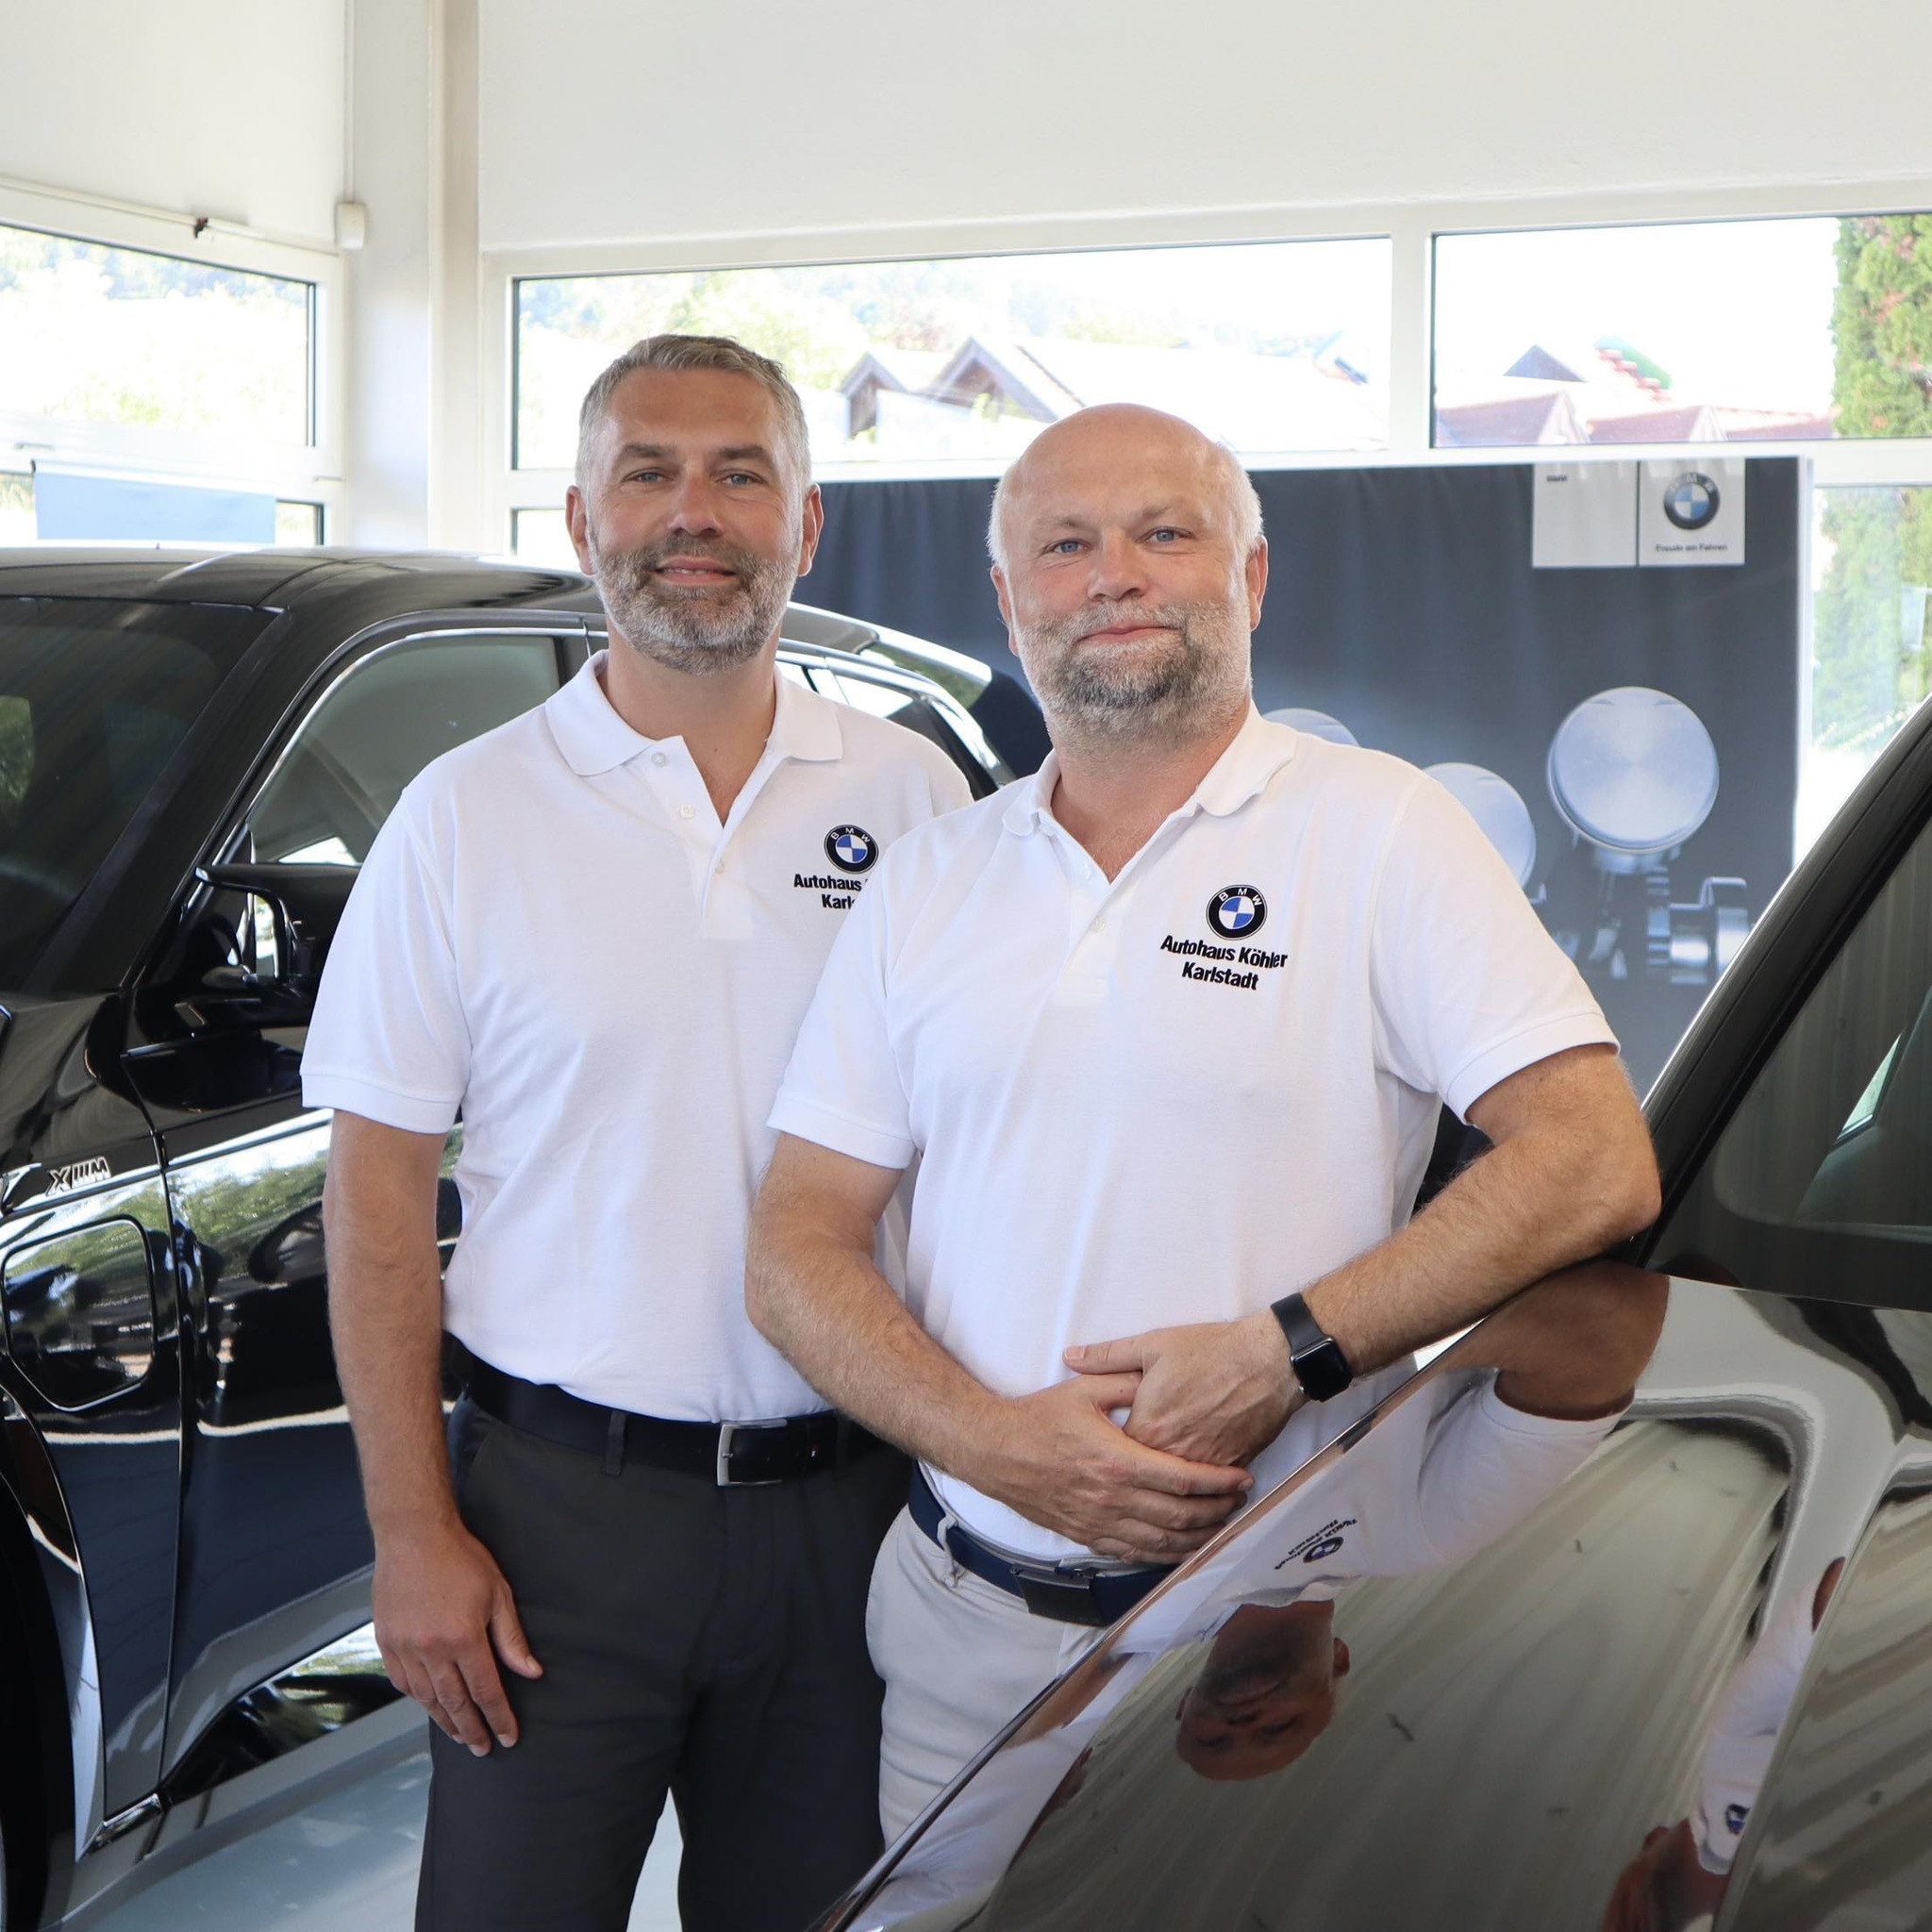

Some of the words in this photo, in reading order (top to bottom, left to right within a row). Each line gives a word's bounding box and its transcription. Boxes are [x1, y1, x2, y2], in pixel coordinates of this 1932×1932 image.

[830, 827, 871, 843] BMW
[793, 874, 862, 891] Autohaus
[821, 893, 856, 909] Karl
[1218, 888, 1262, 907] BMW
[1160, 935, 1236, 961] Autohaus
[1238, 946, 1288, 969] Köhler
[1181, 961, 1259, 991] Karlstadt
